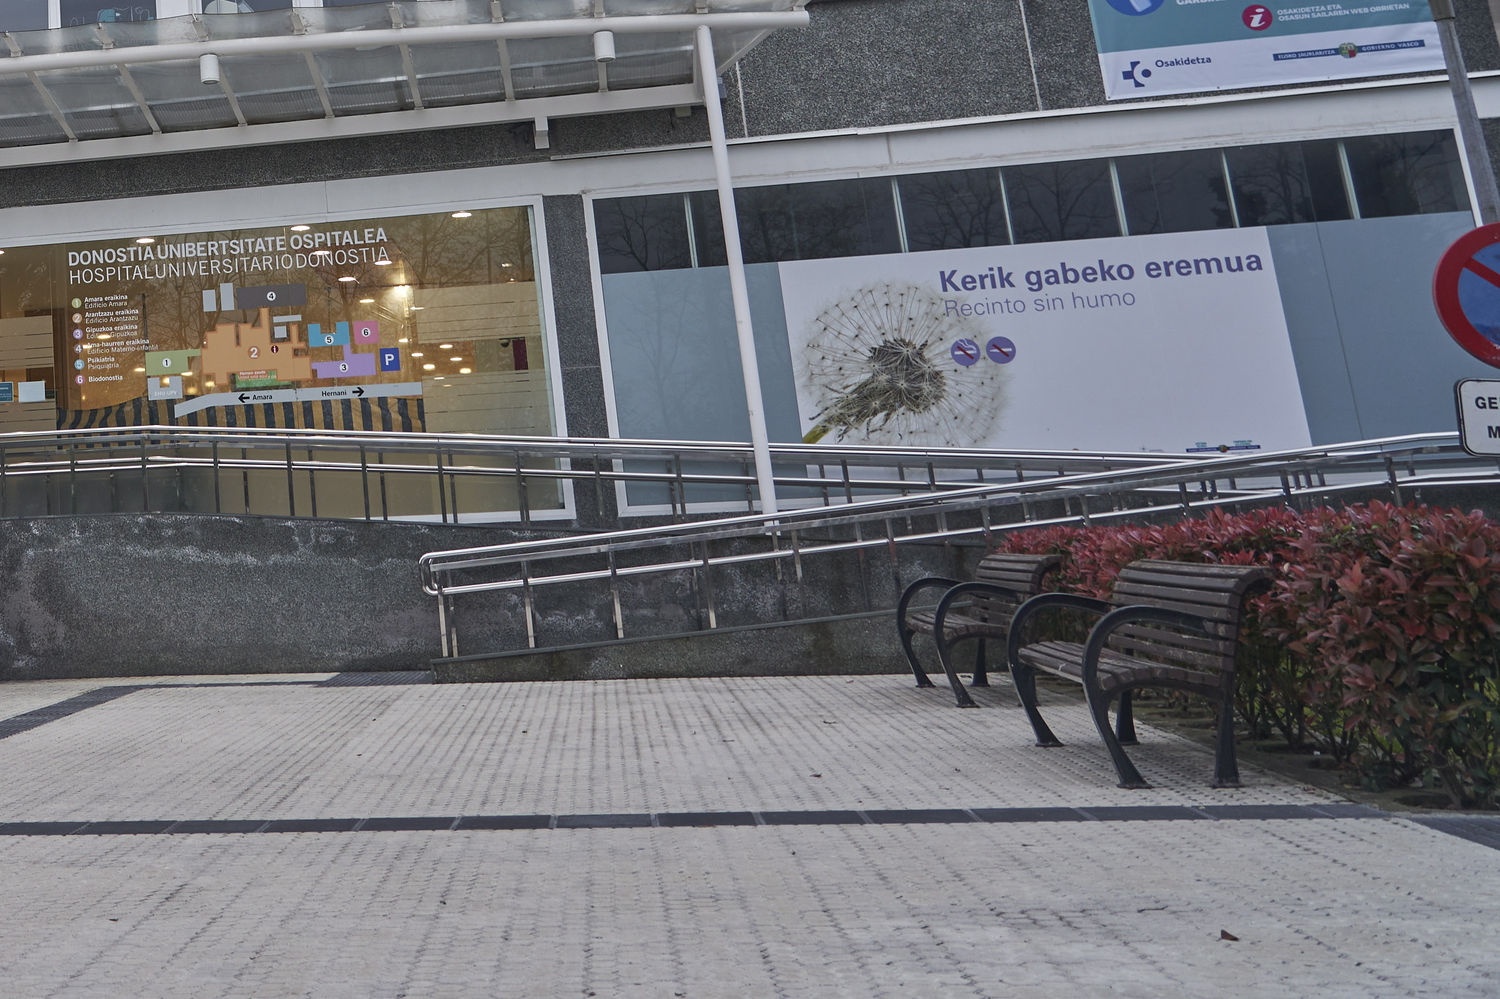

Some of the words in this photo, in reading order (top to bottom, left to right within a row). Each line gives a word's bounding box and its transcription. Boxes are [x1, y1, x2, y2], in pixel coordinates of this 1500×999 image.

[1155, 55, 1212, 70] Osakidetza
[68, 246, 154, 266] DONOSTIA
[157, 236, 286, 258] UNIBERTSITATE
[290, 227, 388, 250] OSPITALEA
[70, 264, 154, 284] HOSPITAL
[155, 253, 293, 279] UNIVERSITARIO
[296, 246, 389, 268] DONOSTIA
[940, 259, 1016, 293] Kerik
[1024, 259, 1136, 293] gabeko
[1144, 252, 1264, 280] eremua
[944, 294, 1026, 318] Recinto
[1033, 293, 1066, 313] sin
[1072, 288, 1136, 310] humo
[250, 348, 258, 358] 2
[385, 354, 394, 365] P
[1475, 396, 1500, 409] GE
